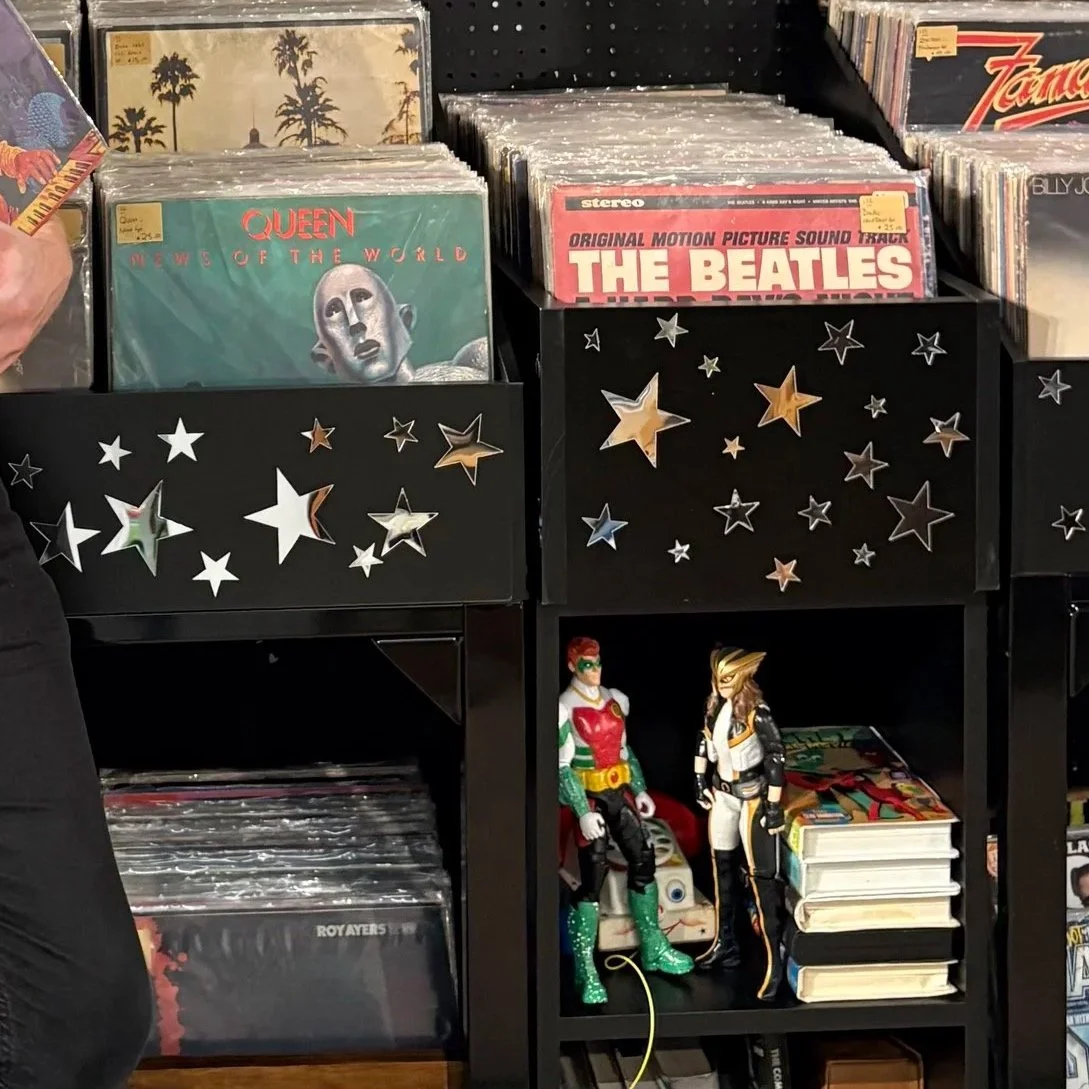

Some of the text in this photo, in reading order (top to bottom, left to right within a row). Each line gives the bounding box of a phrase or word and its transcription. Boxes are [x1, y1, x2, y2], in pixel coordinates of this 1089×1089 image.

[1032, 176, 1073, 195] BILLY
[580, 197, 645, 209] stereo
[241, 206, 355, 241] QUEEN
[568, 230, 910, 248] ORIGINAL MOTION PICTURE SOUND TRACK
[129, 245, 470, 268] NEWS OF THE WORLD
[568, 245, 913, 293] THE BEATLES
[316, 924, 345, 937] ROY
[345, 923, 386, 936] AYERS
